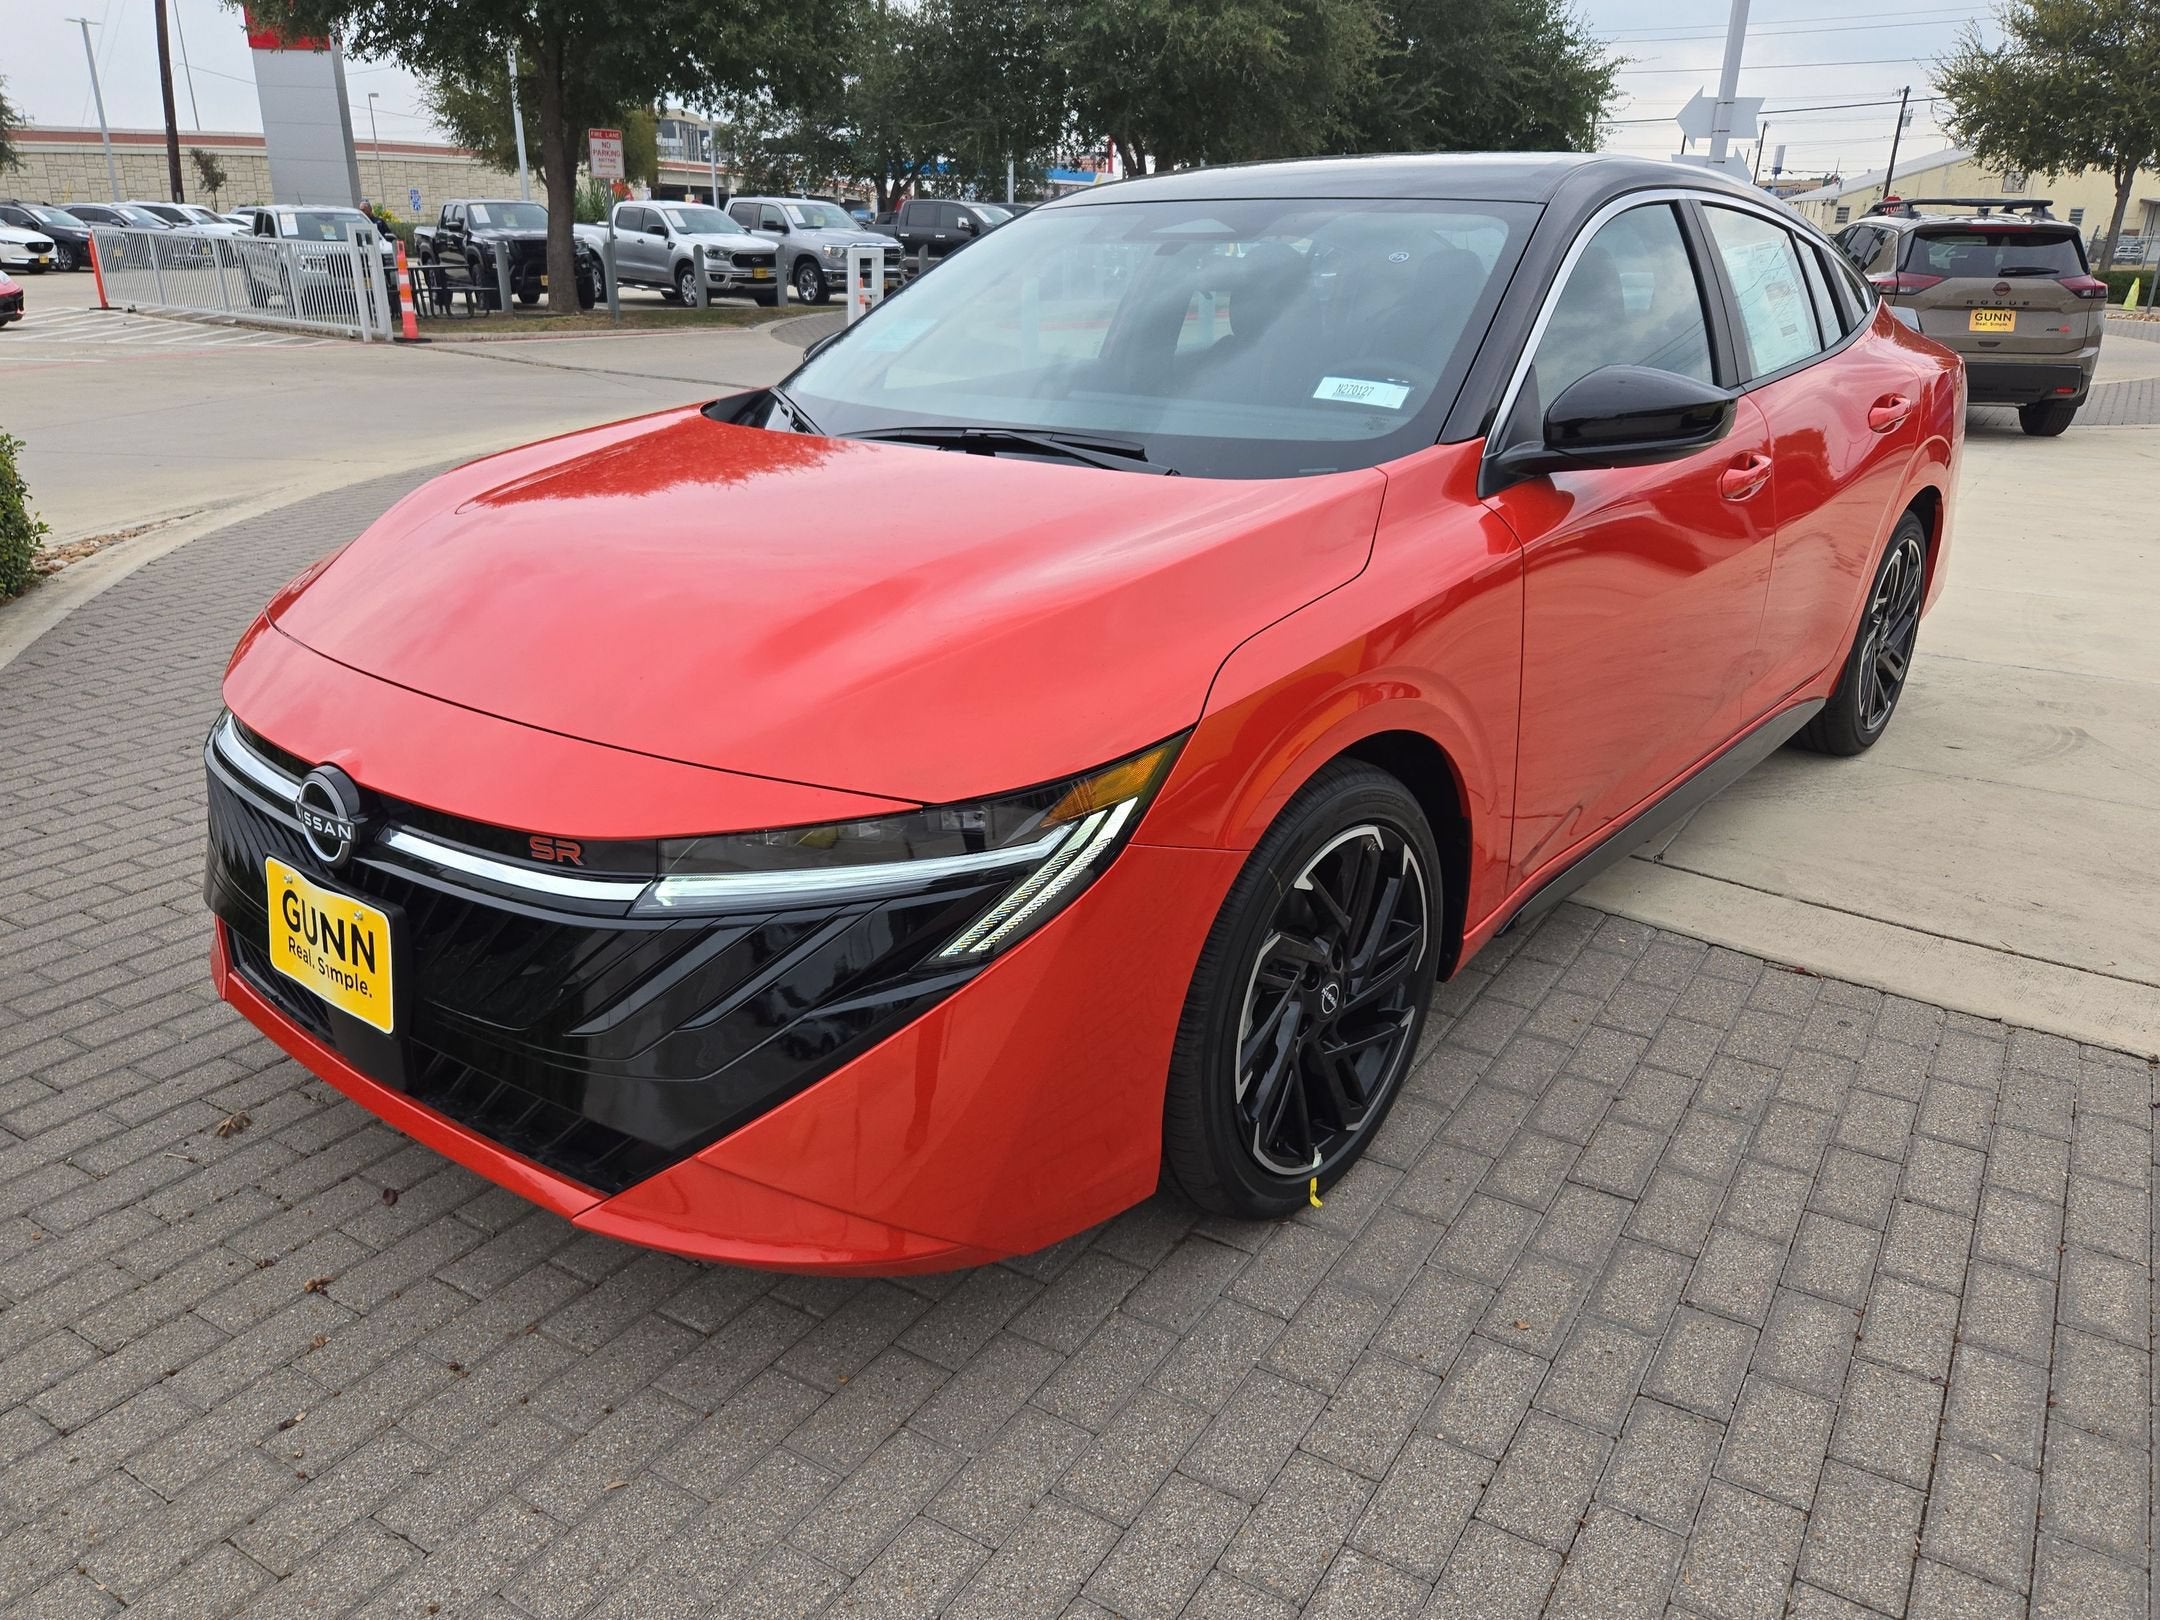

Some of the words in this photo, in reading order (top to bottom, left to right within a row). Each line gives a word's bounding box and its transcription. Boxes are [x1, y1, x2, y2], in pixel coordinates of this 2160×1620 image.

[602, 141, 611, 149] NO
[592, 149, 621, 157] PARKING
[1975, 312, 2012, 321] GUNN
[1335, 383, 1375, 397] N270127
[529, 836, 585, 866] SR
[282, 889, 376, 974] GUNN
[288, 935, 316, 969] Real.
[317, 957, 373, 998] Simple.
